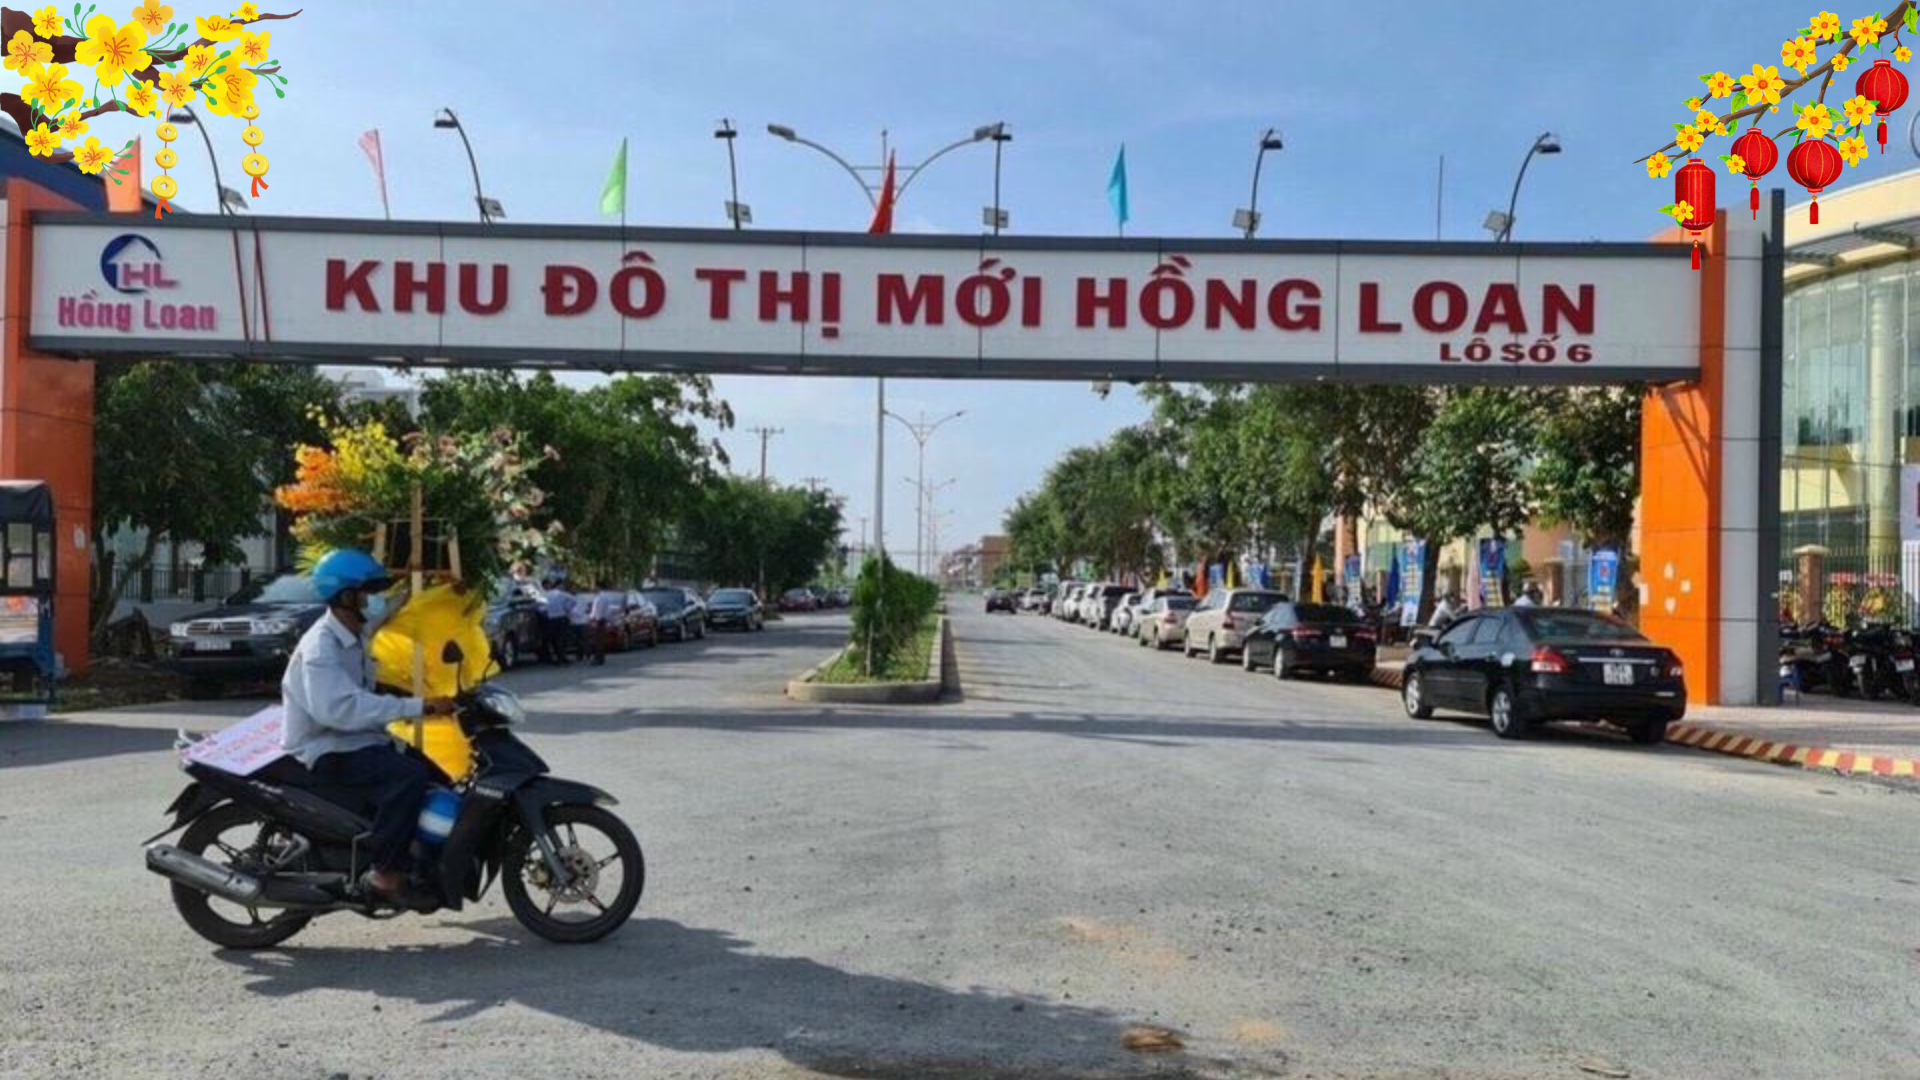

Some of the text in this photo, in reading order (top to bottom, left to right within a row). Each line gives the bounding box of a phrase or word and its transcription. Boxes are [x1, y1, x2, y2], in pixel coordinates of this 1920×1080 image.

[123, 263, 179, 289] HL
[326, 250, 1595, 338] KHU ĐÔ THỊ MỚI HỒNG LOAN
[58, 289, 216, 333] Hồng Loan
[1440, 334, 1592, 363] LÔ SỐ 6
